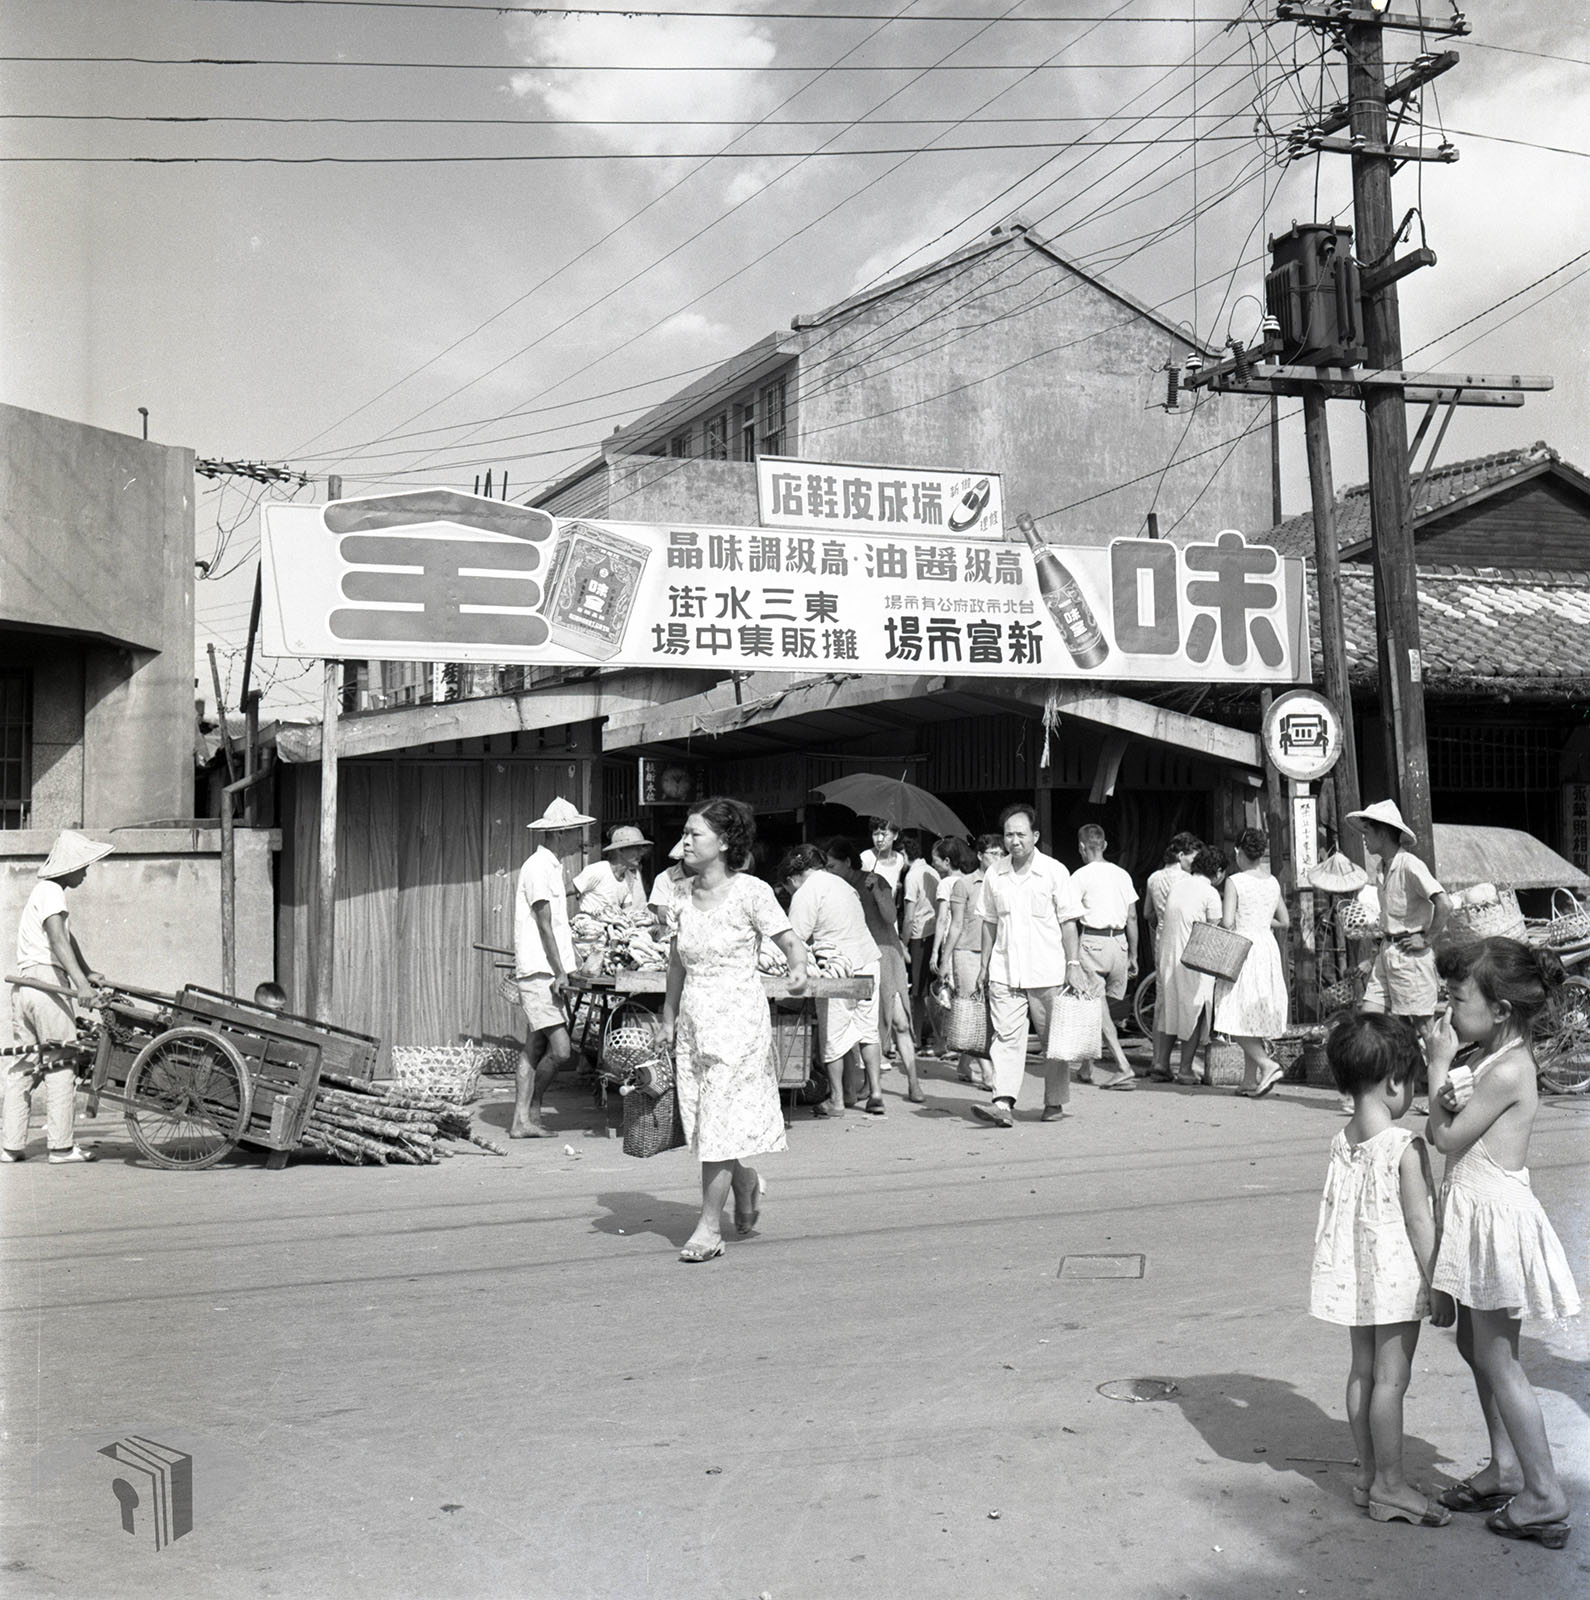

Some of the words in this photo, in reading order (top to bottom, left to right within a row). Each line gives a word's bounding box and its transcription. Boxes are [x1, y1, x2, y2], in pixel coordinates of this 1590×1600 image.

[322, 488, 556, 646] 全
[669, 585, 839, 623] 東三水街
[884, 595, 1034, 614] 台北市政府公有市場
[1112, 530, 1285, 667] 味
[651, 622, 859, 660] 攤販集中場
[884, 616, 1043, 664] 新富市場
